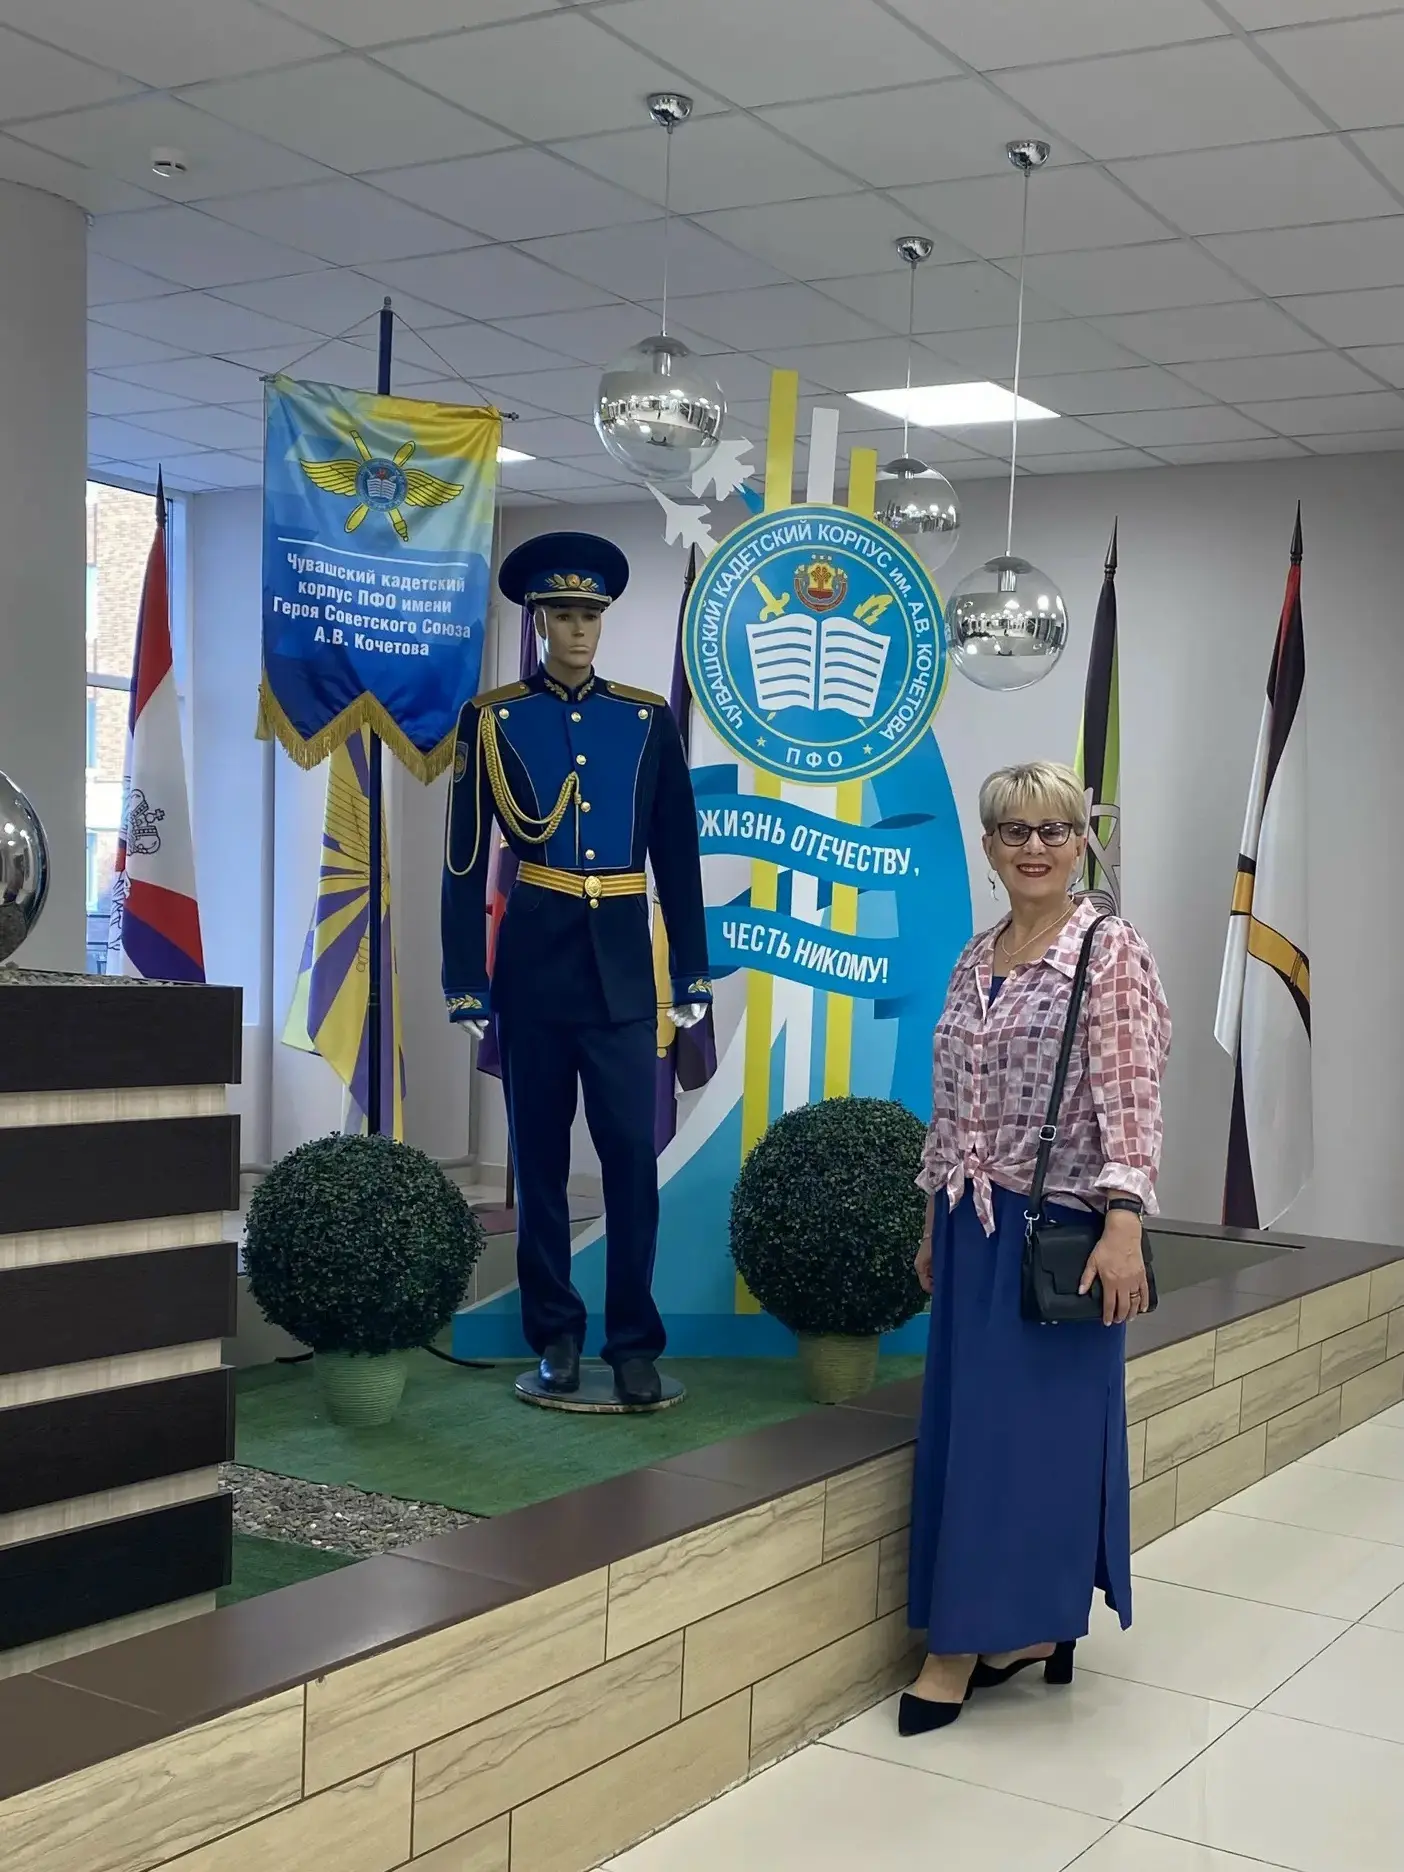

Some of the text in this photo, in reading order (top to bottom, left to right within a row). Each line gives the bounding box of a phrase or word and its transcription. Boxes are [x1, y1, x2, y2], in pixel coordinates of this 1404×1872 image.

[712, 519, 812, 601] КАДЕТСКИЙ
[818, 524, 895, 569] КОРПУС
[286, 553, 466, 593] Чувашский кадетский
[298, 581, 452, 613] корпус ПФО имени
[273, 597, 471, 639] Героя Советского Союза
[907, 600, 930, 638] А.В.
[314, 626, 430, 657] А.В. Кочетова
[701, 600, 744, 730] ЧУВАШСКИЙ
[879, 642, 932, 741] КОЧЕТОВА
[785, 747, 843, 768] ПФО
[698, 809, 787, 845] ЖИЗНЬ
[722, 921, 889, 984] ЧЕСТЬ НИКОМУ!
